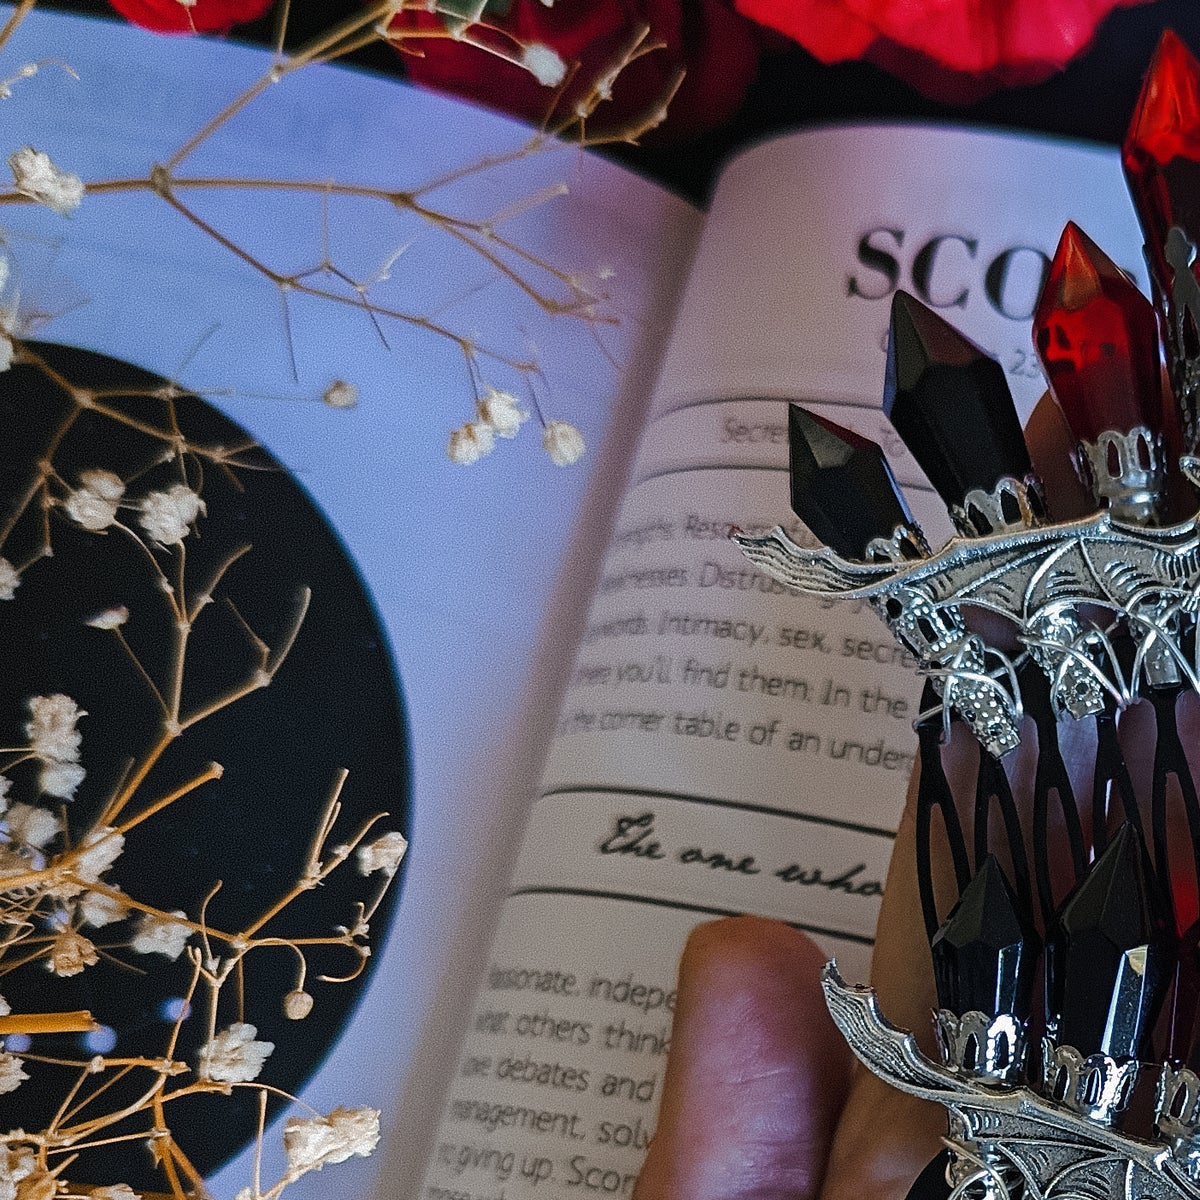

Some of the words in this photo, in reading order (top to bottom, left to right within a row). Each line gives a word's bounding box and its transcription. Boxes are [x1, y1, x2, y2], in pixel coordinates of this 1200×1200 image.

[683, 657, 733, 689] find
[860, 686, 909, 719] the
[674, 711, 741, 742] table
[749, 719, 782, 747] of
[788, 730, 821, 754] an
[598, 812, 666, 860] The
[680, 849, 761, 876] one
[775, 863, 885, 897] who
[516, 1009, 592, 1045] others
[497, 1050, 590, 1092] debates
[602, 1070, 657, 1102] and
